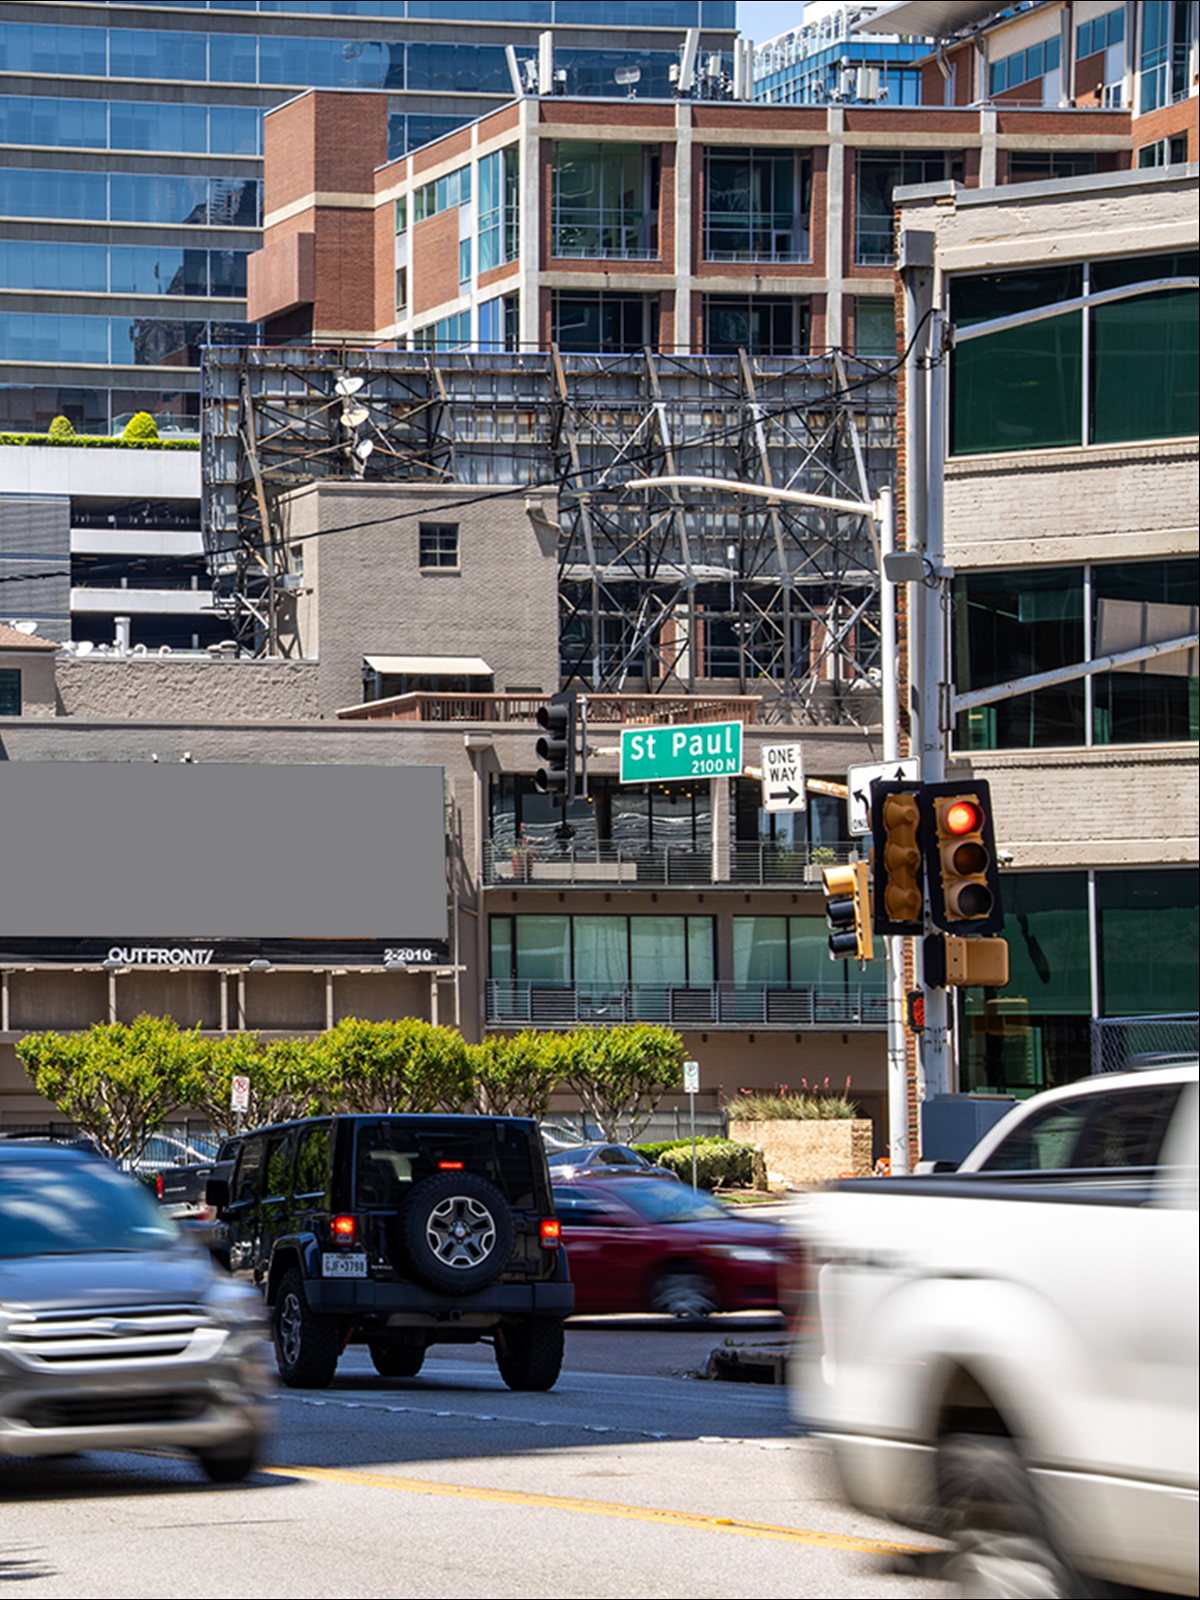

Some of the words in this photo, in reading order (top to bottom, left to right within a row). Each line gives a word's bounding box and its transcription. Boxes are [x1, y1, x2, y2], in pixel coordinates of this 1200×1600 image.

[630, 734, 656, 761] St
[672, 727, 733, 757] Paul
[767, 748, 795, 765] ONE
[691, 759, 724, 774] 2100
[726, 758, 736, 771] N
[770, 767, 797, 782] WAY
[383, 948, 432, 962] 2-2010
